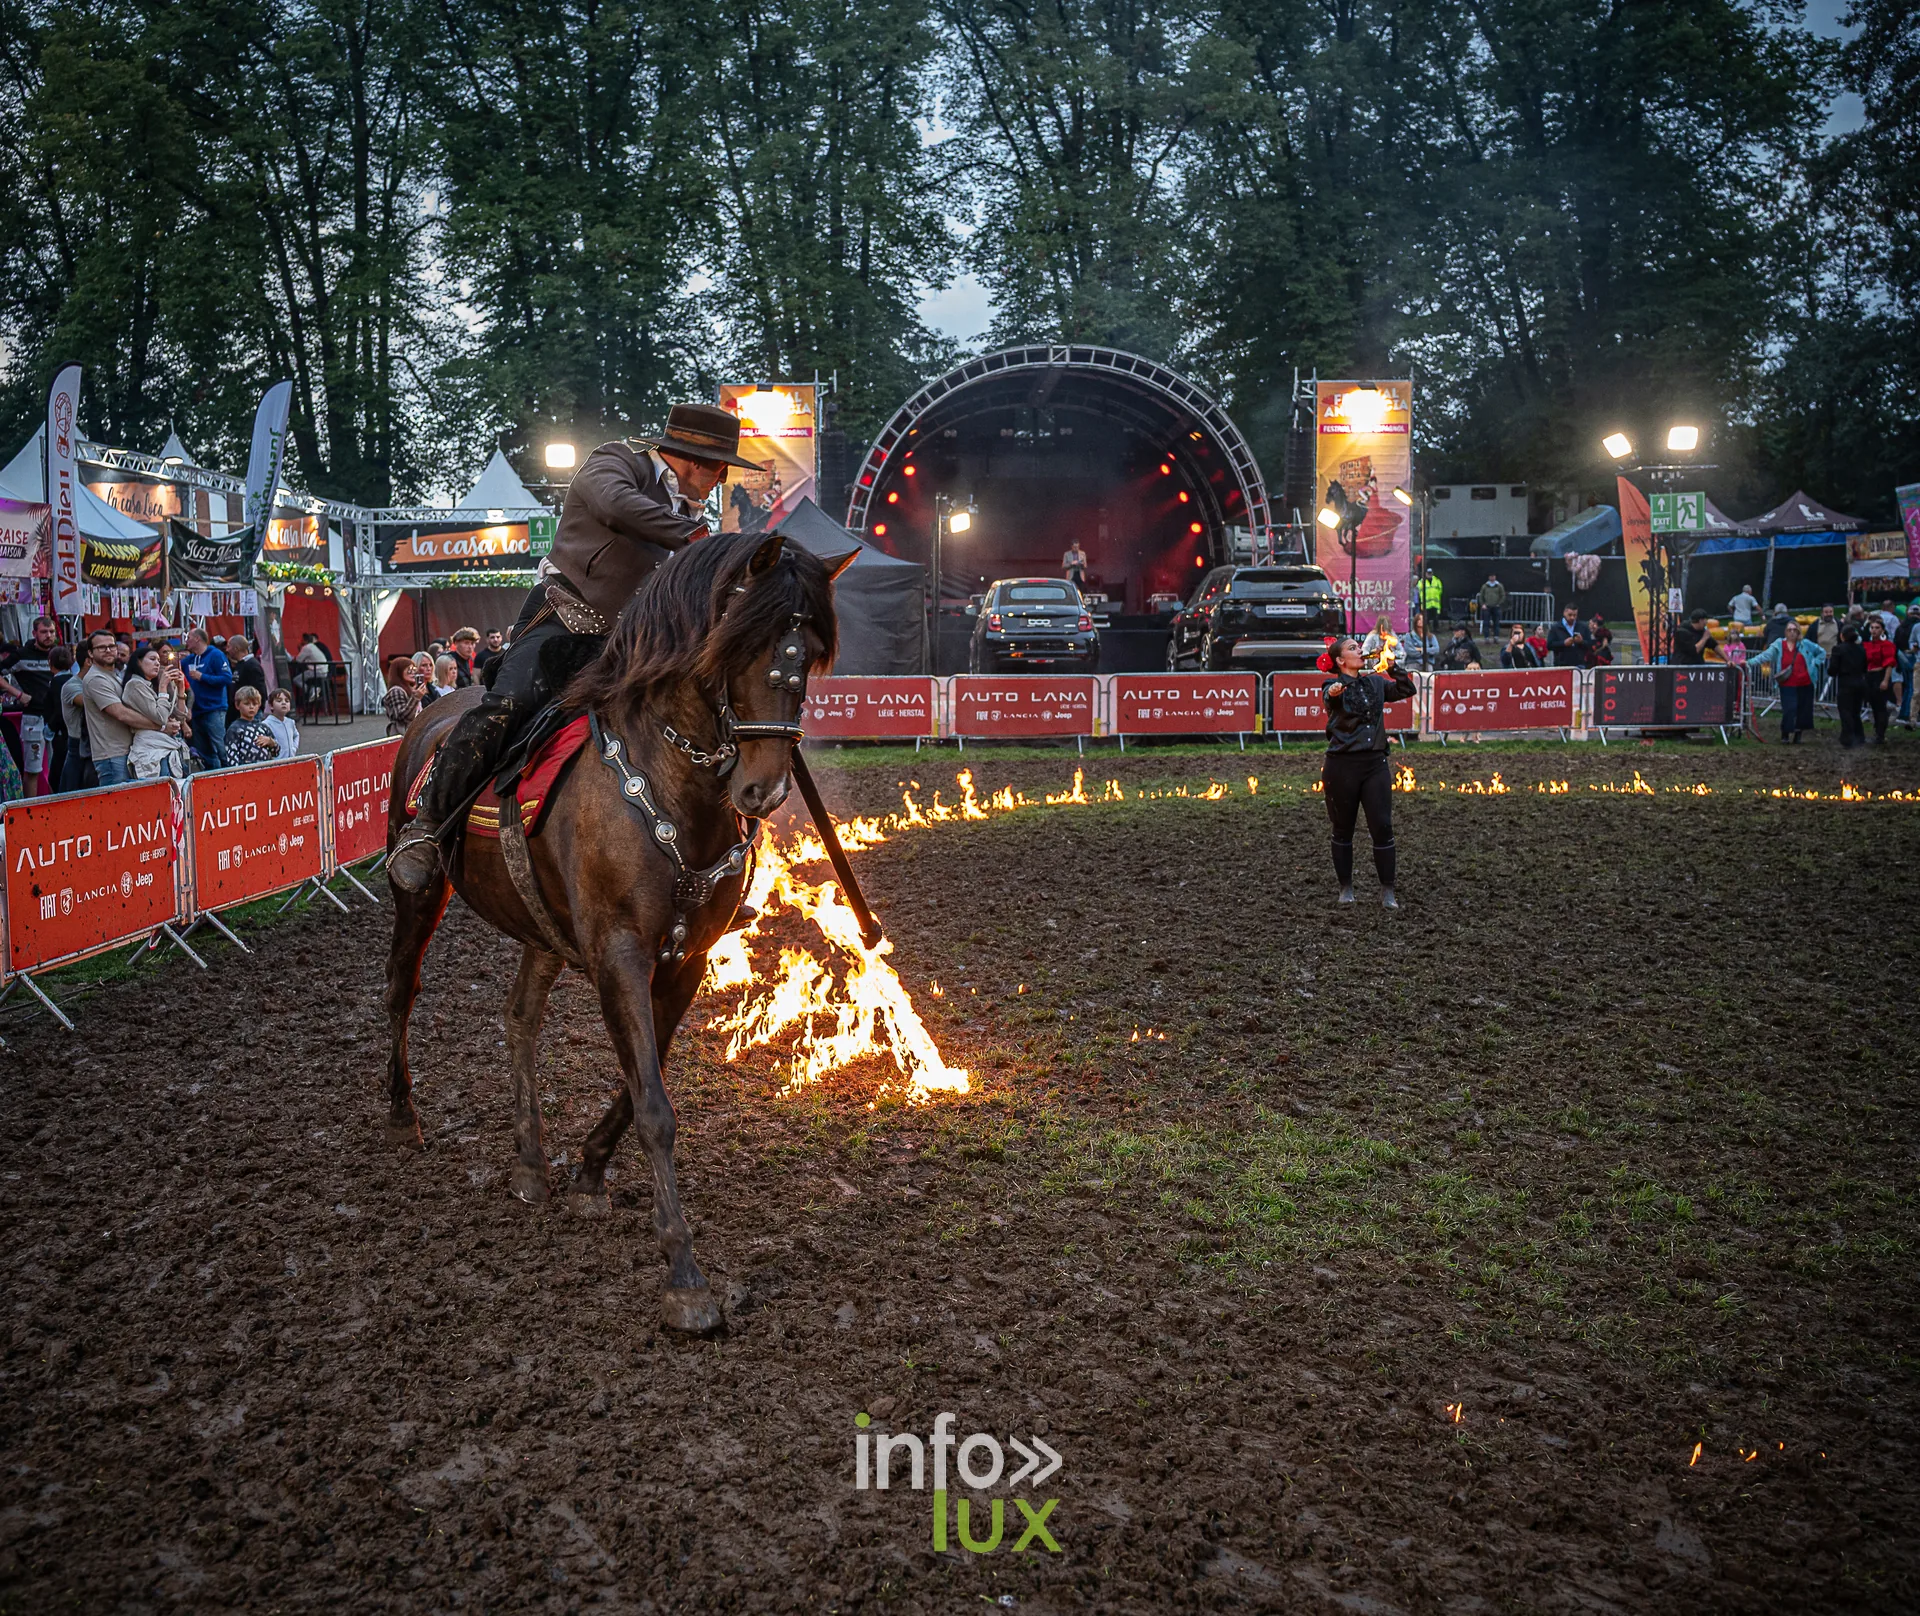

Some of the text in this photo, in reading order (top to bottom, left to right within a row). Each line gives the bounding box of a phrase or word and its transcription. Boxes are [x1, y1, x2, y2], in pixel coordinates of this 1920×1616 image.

[1654, 517, 1670, 526] EXIT
[412, 525, 531, 558] la casa loc
[532, 540, 550, 550] EXIT
[90, 563, 113, 578] TAPAS
[112, 566, 118, 579] Y
[866, 694, 925, 704] LANA
[961, 692, 1088, 702] AUTO LANA
[1123, 688, 1249, 700] AUTO LANA
[1279, 688, 1322, 698] AUT
[1440, 685, 1566, 700] AUTO LANA
[1604, 673, 1616, 722] TOBY
[1618, 672, 1654, 682] VINS
[1675, 672, 1688, 721] TOBY
[1688, 672, 1725, 682] VINS
[1054, 712, 1072, 720] Jeep
[1216, 708, 1234, 716] Jeep
[338, 778, 370, 804] AUTO
[200, 790, 314, 832] AUTO LANA
[16, 818, 167, 872] AUTO LANA
[218, 834, 304, 871] FIAT LANCIA Jeep
[40, 872, 153, 920] FIAT LANCIA Jeep
